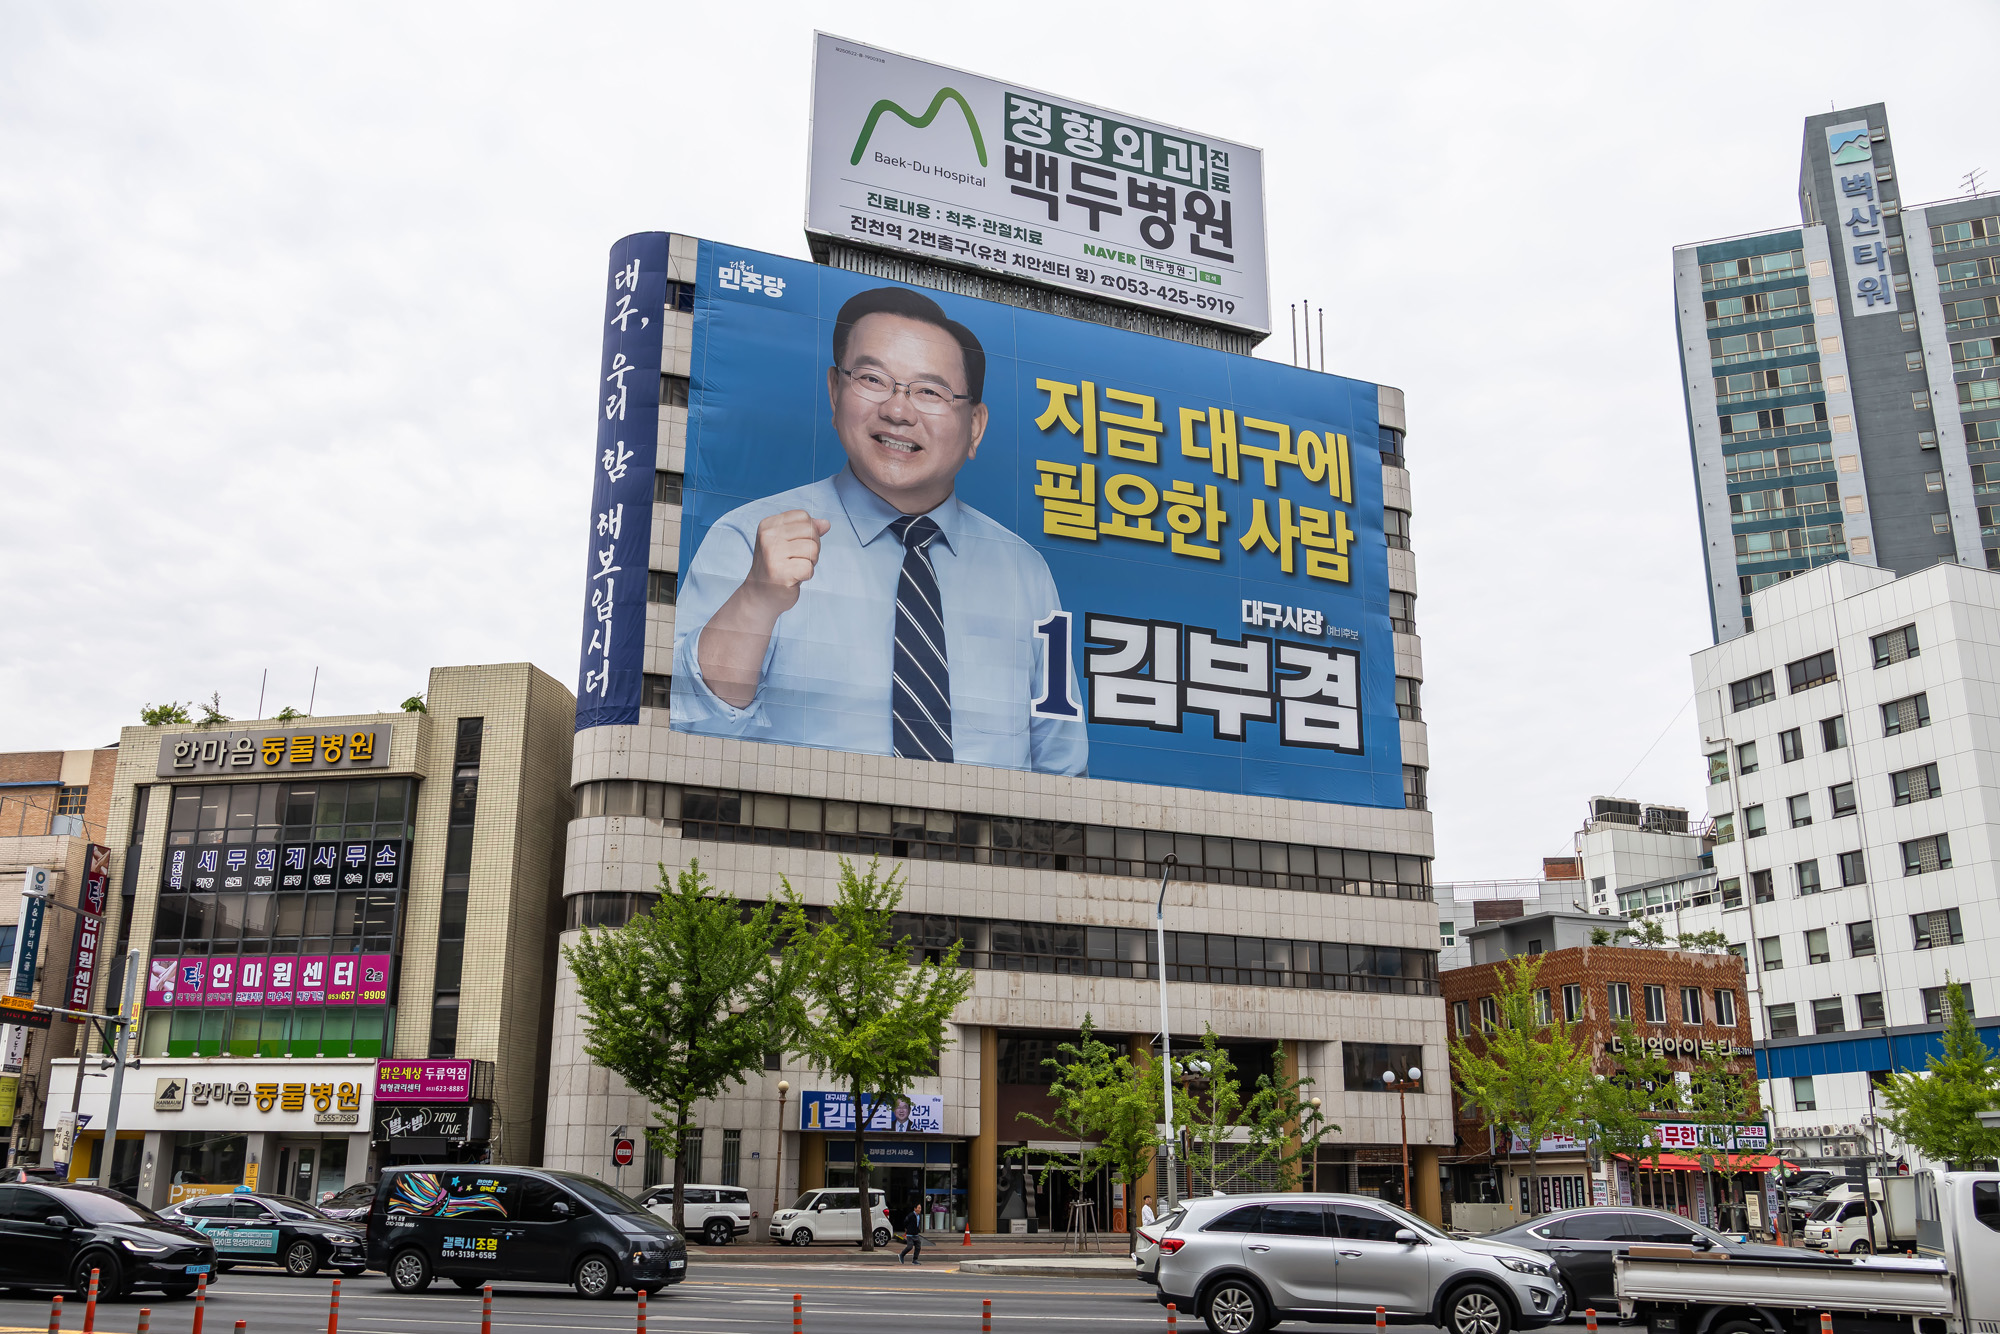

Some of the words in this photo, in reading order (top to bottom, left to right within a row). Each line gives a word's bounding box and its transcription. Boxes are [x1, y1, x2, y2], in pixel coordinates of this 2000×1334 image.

[1009, 97, 1205, 186] 정형외과
[874, 151, 930, 174] Baek-Du
[934, 165, 986, 187] Hospital
[1210, 148, 1231, 194] 진료
[867, 191, 931, 220] 진료내용
[945, 209, 1043, 246] 척추·관절치료
[1005, 145, 1234, 264] 백두병원
[1083, 243, 1137, 266] NAVER
[1840, 171, 1891, 307] 벽산타워
[729, 260, 754, 273] 더불어
[850, 214, 902, 240] 진천역
[908, 228, 1007, 264] 2번출구(유천
[1012, 253, 1070, 279] 치안센터
[1075, 267, 1095, 284] 옆)
[1116, 276, 1235, 315] 053-425-5919
[1144, 258, 1186, 277] 백두병원
[610, 258, 649, 332] 대구,
[718, 266, 786, 298] 민주당
[605, 353, 635, 421] 우리
[1034, 377, 1164, 464] 지금
[1178, 406, 1352, 504] 대구에
[1034, 459, 1227, 561] 필요한
[1238, 497, 1355, 583] 사람
[1241, 599, 1324, 636] 대구시장
[1326, 624, 1359, 641] 예비후보
[1031, 609, 1082, 722] 1
[1086, 613, 1362, 753] 김부겸
[170, 850, 185, 890] 최진혁
[196, 877, 214, 888] 기장
[225, 876, 242, 887] 신고
[254, 875, 272, 886] 세무
[284, 875, 301, 886] 조정
[313, 874, 331, 885] 양도
[344, 873, 362, 884] 상속
[374, 872, 393, 883] 증여
[365, 968, 384, 983] 2층
[379, 1083, 421, 1093] 체형관리센터
[380, 1066, 423, 1080] 밝은세상
[424, 1067, 467, 1080] 두류역점
[825, 1093, 848, 1101] 대구시장
[911, 1105, 930, 1117] 선거
[440, 1124, 462, 1135] LIVE
[808, 1101, 822, 1129] 1
[911, 1118, 940, 1131] 사무소
[442, 1236, 498, 1251] 갤럭시조명
